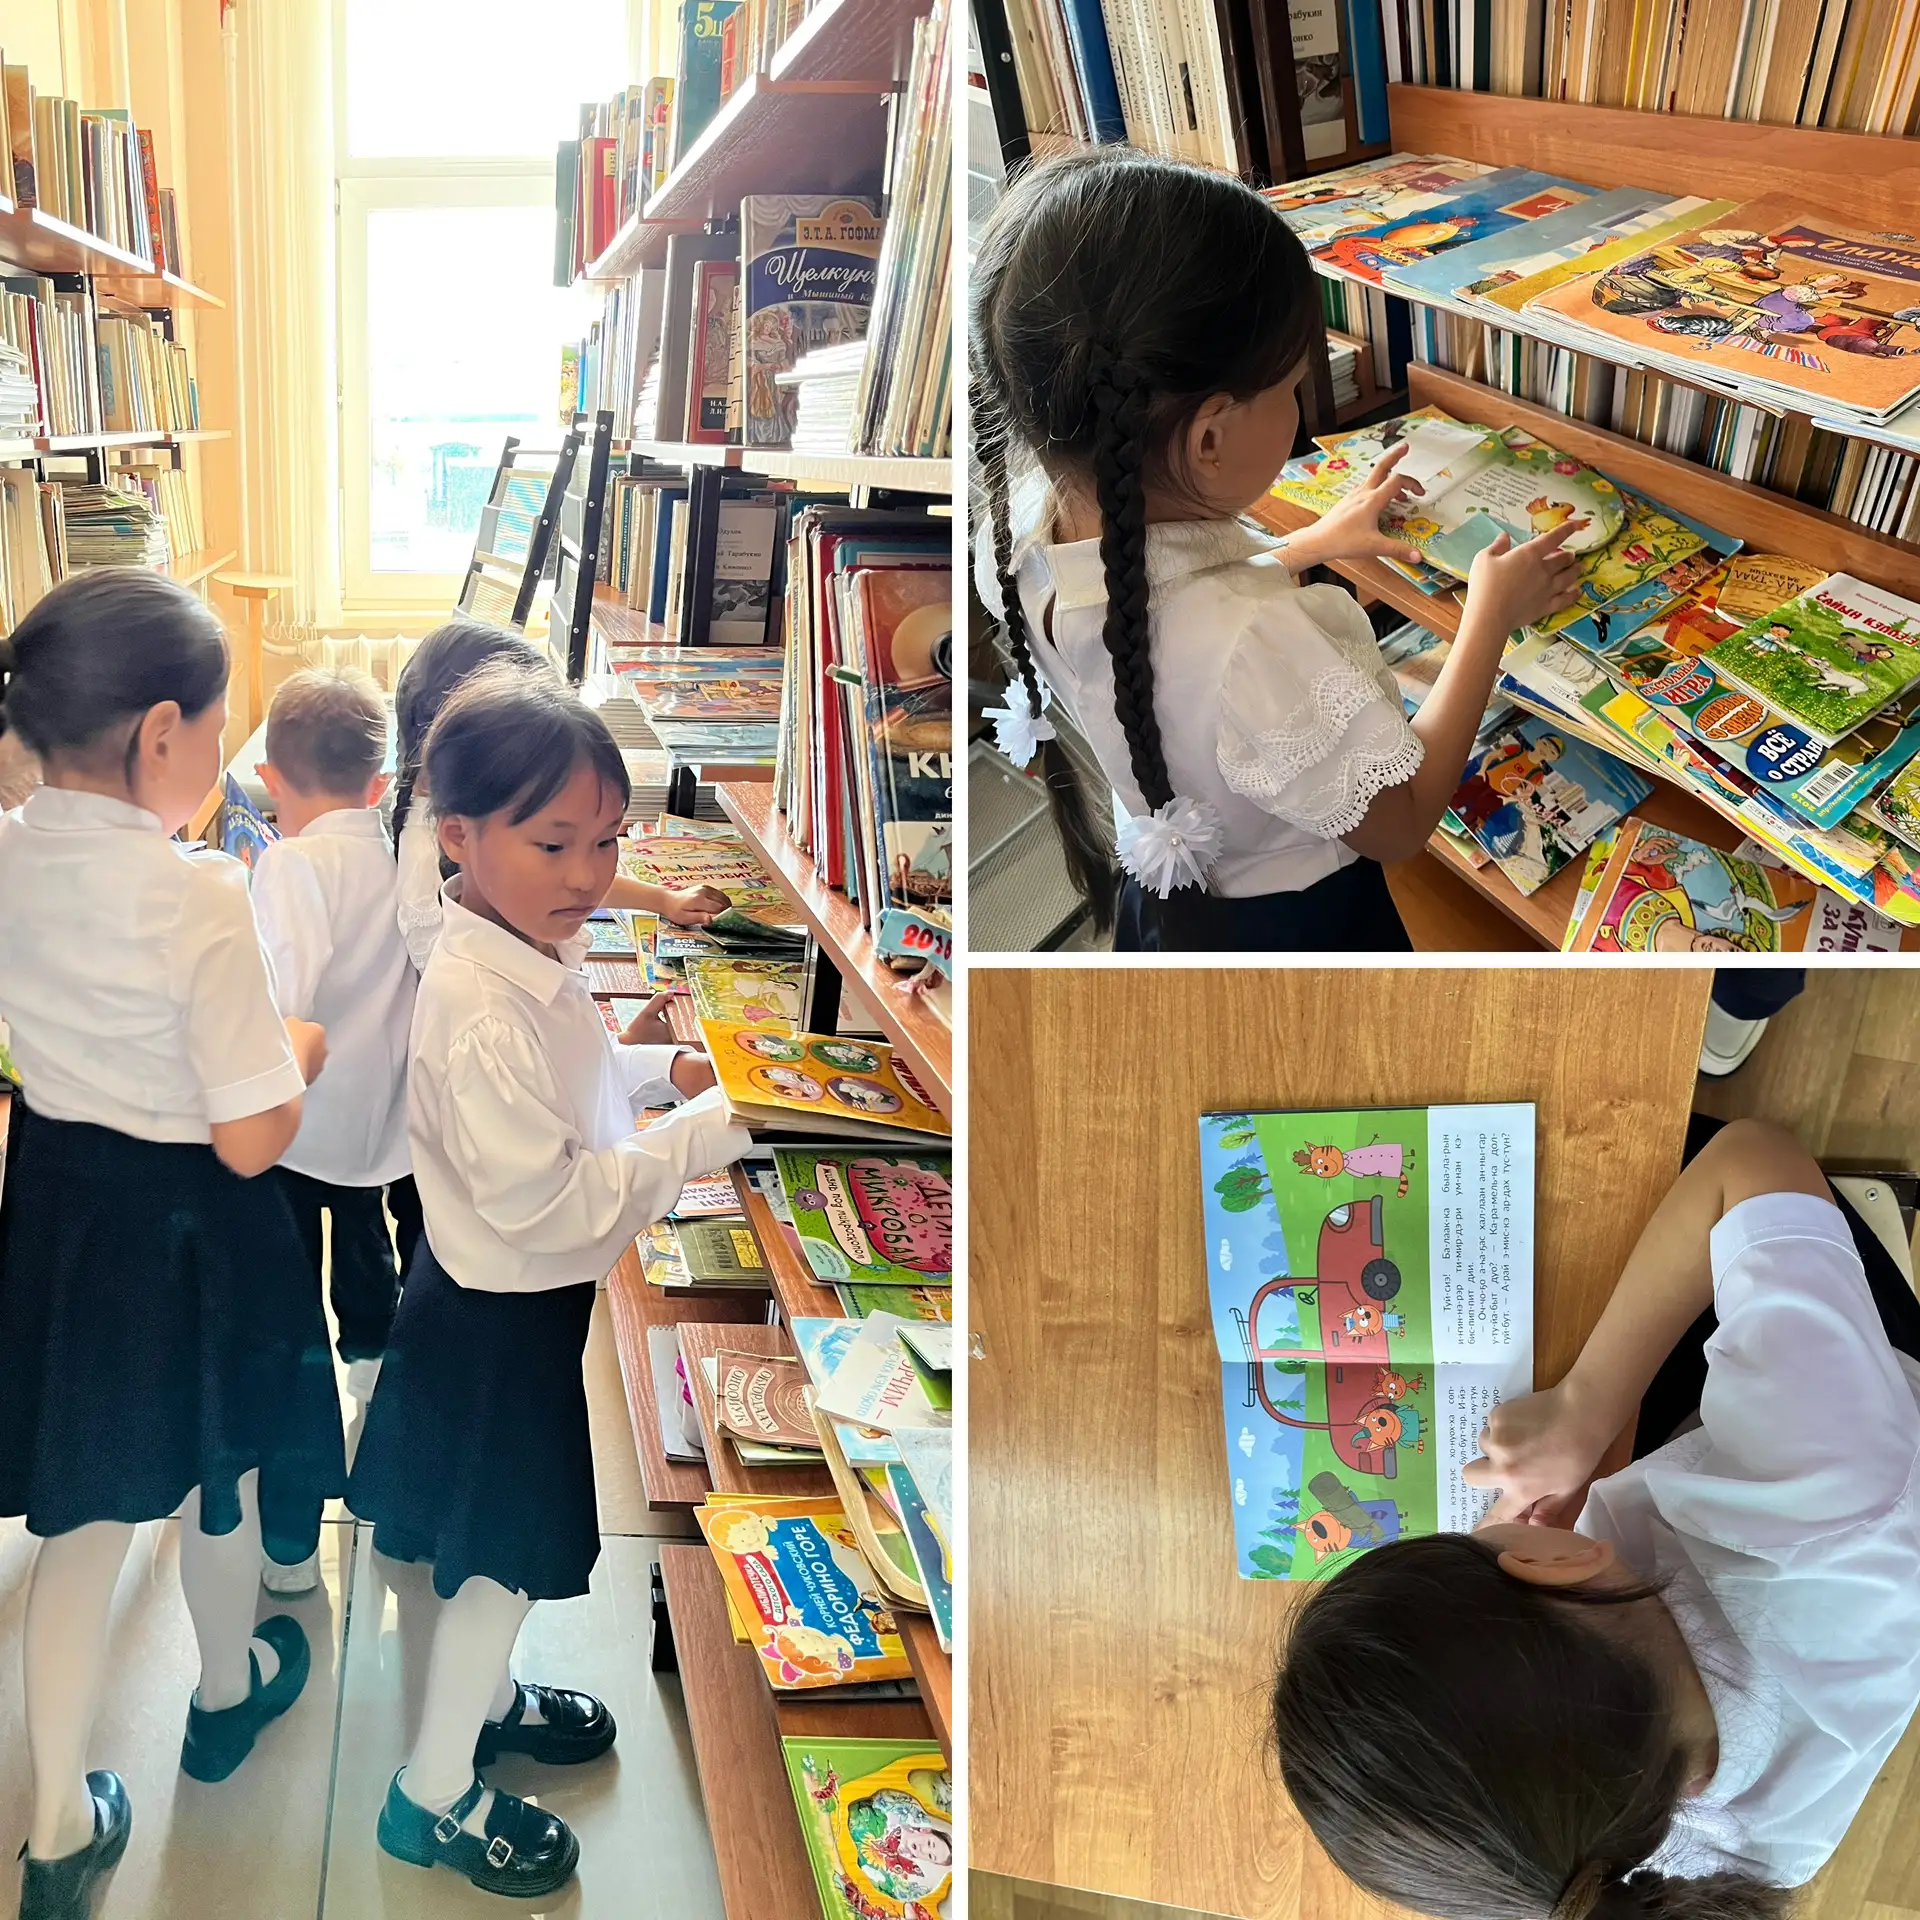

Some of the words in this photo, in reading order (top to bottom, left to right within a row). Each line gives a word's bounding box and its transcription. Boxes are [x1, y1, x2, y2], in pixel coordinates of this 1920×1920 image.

[1149, 37, 1161, 79] РАСТУТ
[1129, 76, 1141, 121] ПОКУДА
[1138, 79, 1151, 124] ПОКУДА
[1157, 84, 1169, 130] ПОКУДА
[803, 227, 837, 240] Э.Т.А.
[802, 289, 855, 301] Мышиный
[1642, 656, 1699, 696] НАСТОЛЬНАЯ
[1661, 673, 1713, 705] ИГРА
[1725, 701, 1765, 735] ЗВЕЗДО
[1758, 729, 1796, 763] ВСЁ
[1441, 1134, 1451, 1193] быа-ла-рын
[1479, 1133, 1487, 1182] ан-ны-гар
[1491, 1133, 1499, 1157] дол-
[1455, 1161, 1463, 1196] ум-нан
[1503, 1179, 1511, 1212] ар-дах
[850, 1163, 923, 1265] МИКРОБАХ
[908, 1213, 928, 1224] О
[1489, 1165, 1499, 1235] Ка-ра-мель-ка
[1441, 1207, 1451, 1259] Ба-лаак-ка
[1455, 1207, 1463, 1273] ти-мир-дэ-ри
[1467, 1262, 1475, 1283] дии.
[1489, 1262, 1499, 1284] дуо?
[1500, 1264, 1511, 1292] А-рай
[1442, 1274, 1453, 1312] Туй-сиэ!
[1467, 1290, 1475, 1345] бис-пип-пит
[1489, 1292, 1500, 1345] у-ту-йа-быт
[1501, 1310, 1511, 1345] гуй-бут.
[1459, 1413, 1467, 1465] бул-бут-тар.
[791, 1526, 821, 1559] ГОРЕ
[783, 1540, 817, 1595] ЧУКОВСКИЙ
[743, 1563, 771, 1615] БИБЛИОТЕЧКА
[811, 1561, 865, 1646] ФЕДОРИНО
[809, 1592, 836, 1629] КОРНЕЙ
